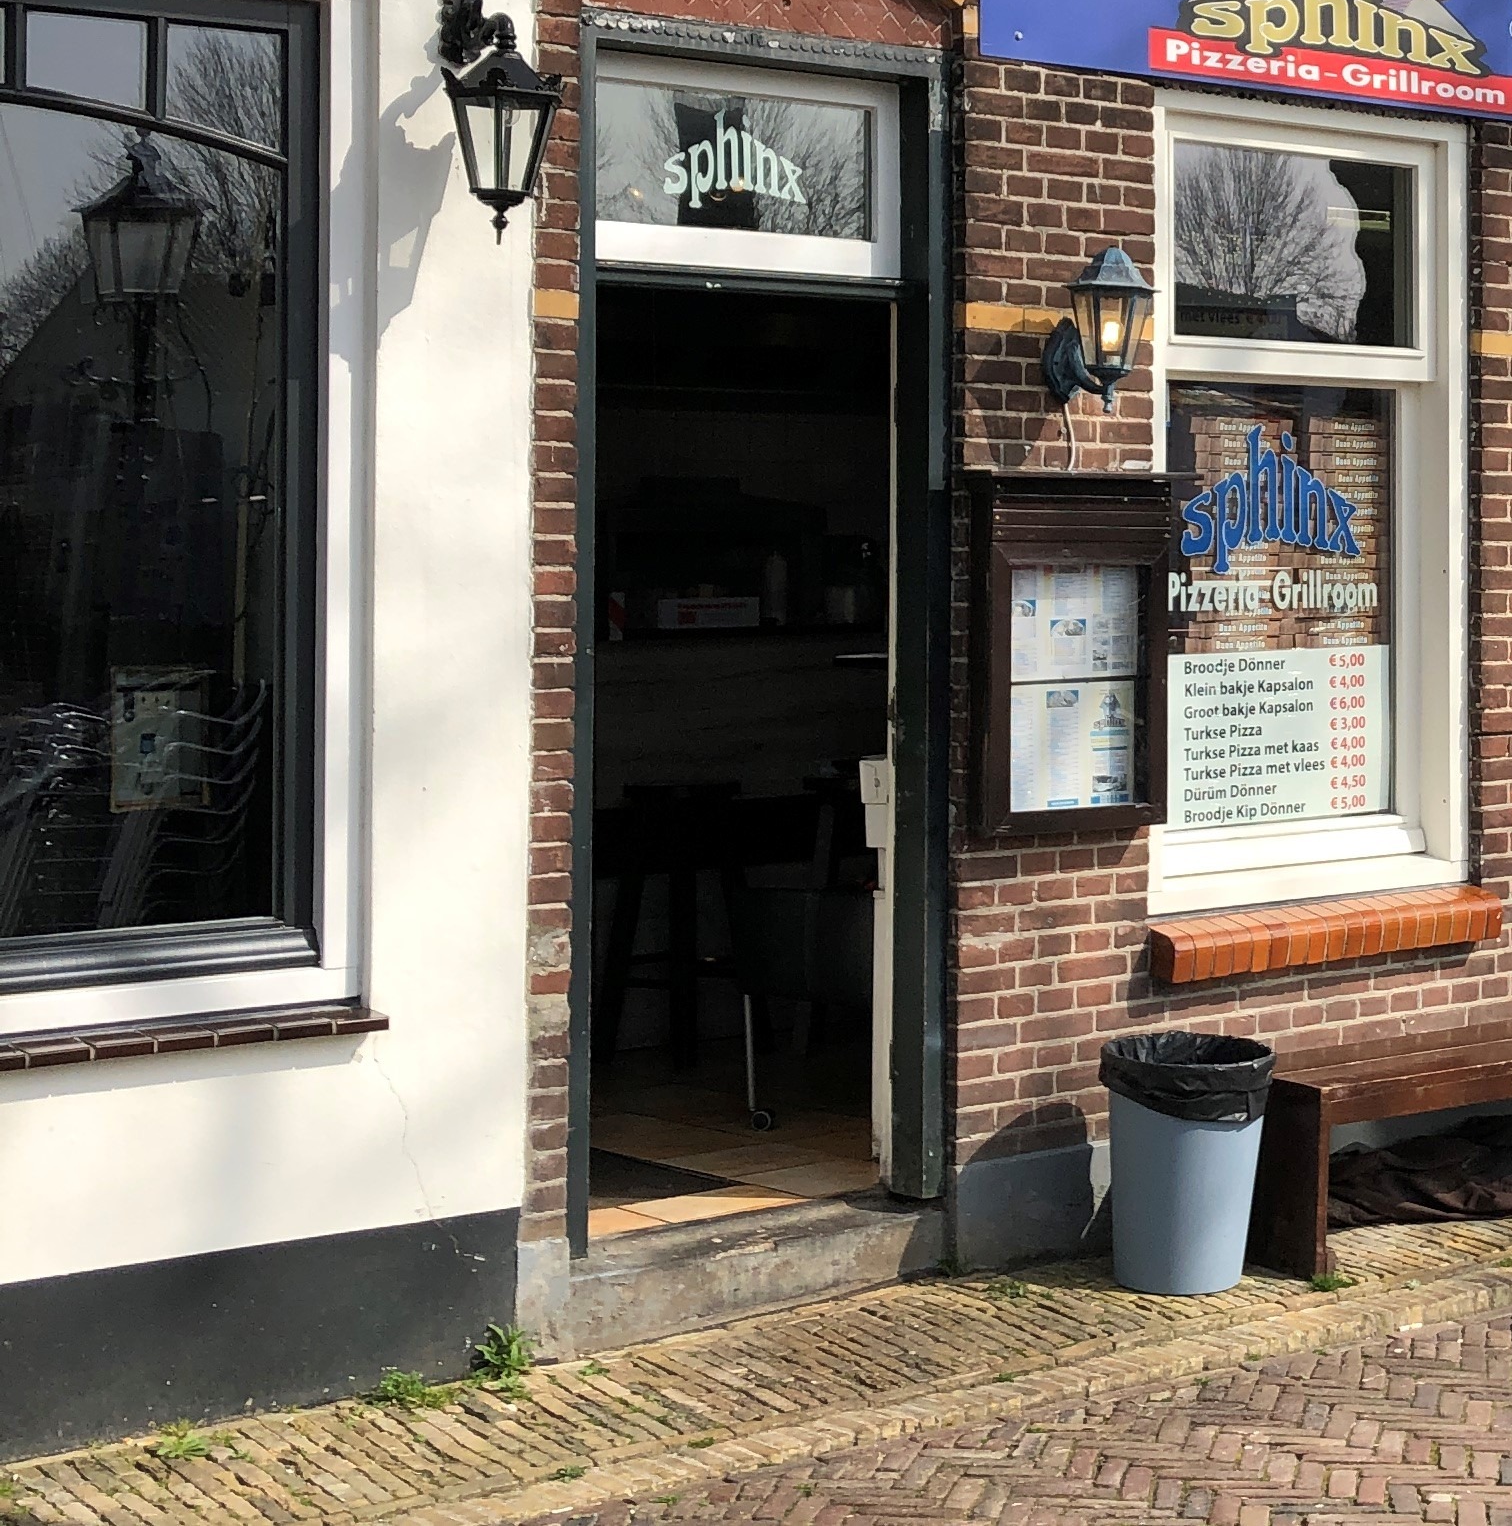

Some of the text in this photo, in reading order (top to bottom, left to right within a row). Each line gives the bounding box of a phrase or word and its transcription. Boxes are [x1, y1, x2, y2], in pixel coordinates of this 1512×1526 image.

[663, 108, 807, 208] sphinx
[1181, 423, 1362, 574] sphinx
[1184, 659, 1235, 676] Broodje
[1238, 657, 1286, 672] Dönner
[1184, 682, 1217, 697] Klein
[1220, 680, 1255, 697] bakje
[1258, 677, 1314, 695] Kapsalon
[1184, 705, 1220, 720] Groot
[1222, 703, 1256, 720] bakje
[1259, 699, 1314, 717] Kapsalon
[1184, 726, 1226, 742] Turkse
[1229, 724, 1263, 738] Pizza
[1184, 746, 1226, 761] Turkse
[1229, 744, 1262, 759] Pizza
[1264, 741, 1289, 755] met
[1291, 739, 1320, 753] kaas
[1184, 765, 1226, 781] Turkse
[1229, 763, 1263, 778] Pizza
[1266, 760, 1290, 774] met
[1294, 757, 1325, 772] vlees
[1184, 786, 1227, 802] Dürüm
[1230, 783, 1278, 798] Dönner
[1184, 807, 1233, 824] Broodje
[1236, 805, 1258, 822] Kip
[1260, 801, 1306, 817] Dönner
